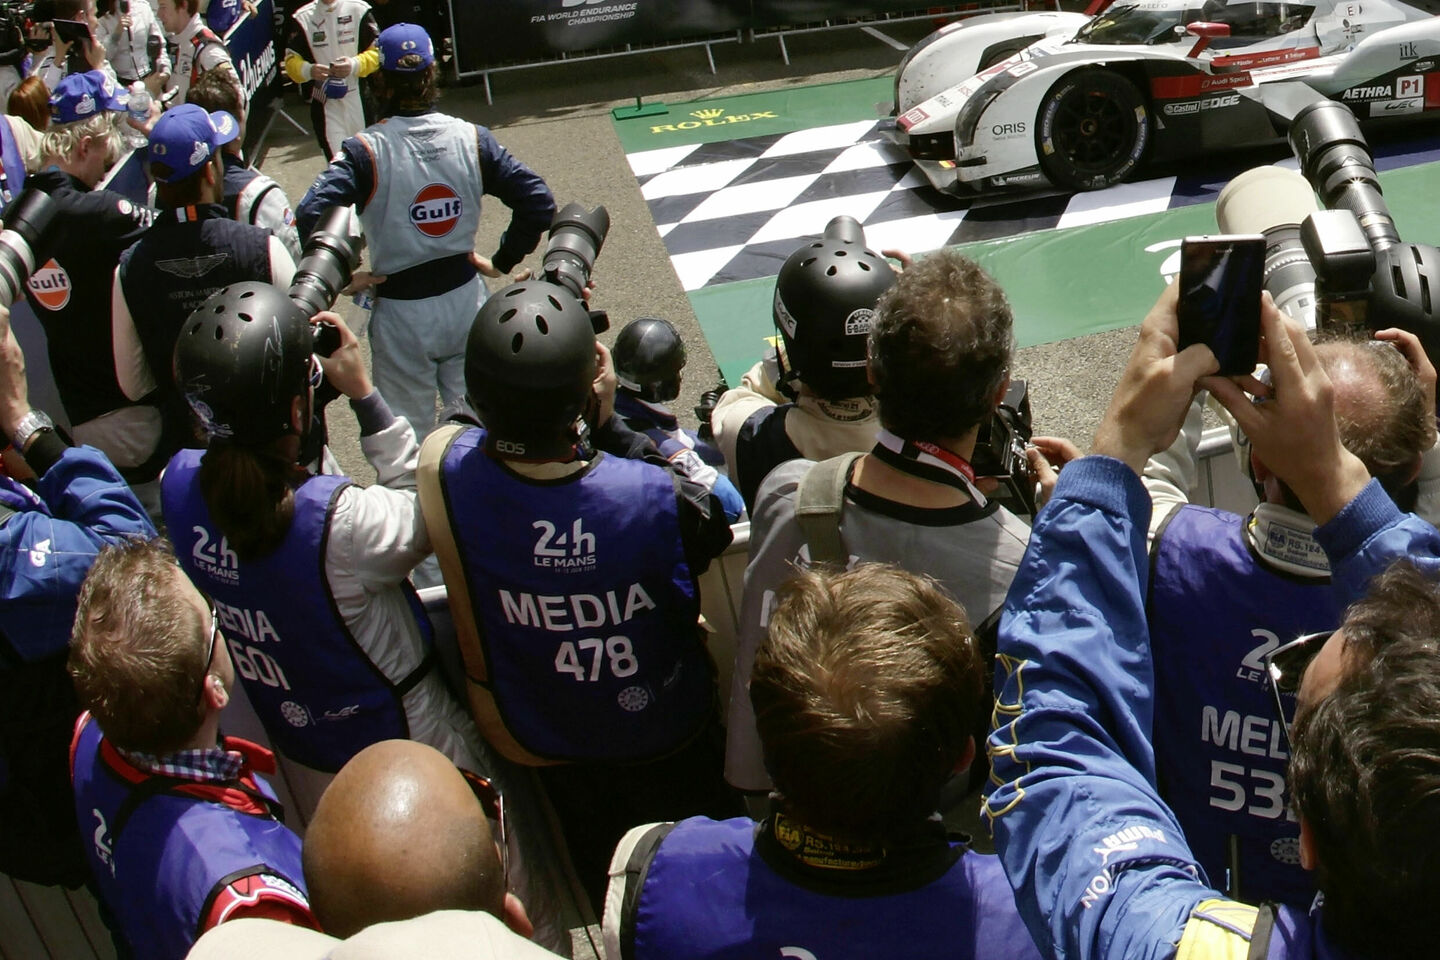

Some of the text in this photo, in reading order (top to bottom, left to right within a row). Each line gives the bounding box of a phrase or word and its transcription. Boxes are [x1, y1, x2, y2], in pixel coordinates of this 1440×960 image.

[530, 2, 638, 24] FIA WORLD ENDURANCE
[568, 11, 636, 26] CHAMPIONSHIP
[1230, 76, 1250, 84] Sport
[1400, 78, 1420, 94] P1
[1342, 86, 1392, 100] AETHRA
[1173, 94, 1241, 113] Castrol EDGE
[1384, 98, 1416, 112] WEC
[650, 110, 780, 134] ROLEX
[992, 122, 1026, 136] ORIS
[1006, 173, 1040, 182] MICHELIN
[411, 200, 460, 220] Gulf
[28, 272, 67, 290] Gulf
[496, 440, 526, 455] EOS
[532, 518, 596, 557] 24h
[192, 525, 239, 569] 24h
[534, 554, 597, 568] LE MANS
[206, 565, 240, 580] MANS
[498, 582, 656, 632] MEDIA
[216, 598, 280, 642] EDIA
[228, 639, 291, 690] 601
[554, 635, 639, 682] 478
[1210, 759, 1298, 822] 53
